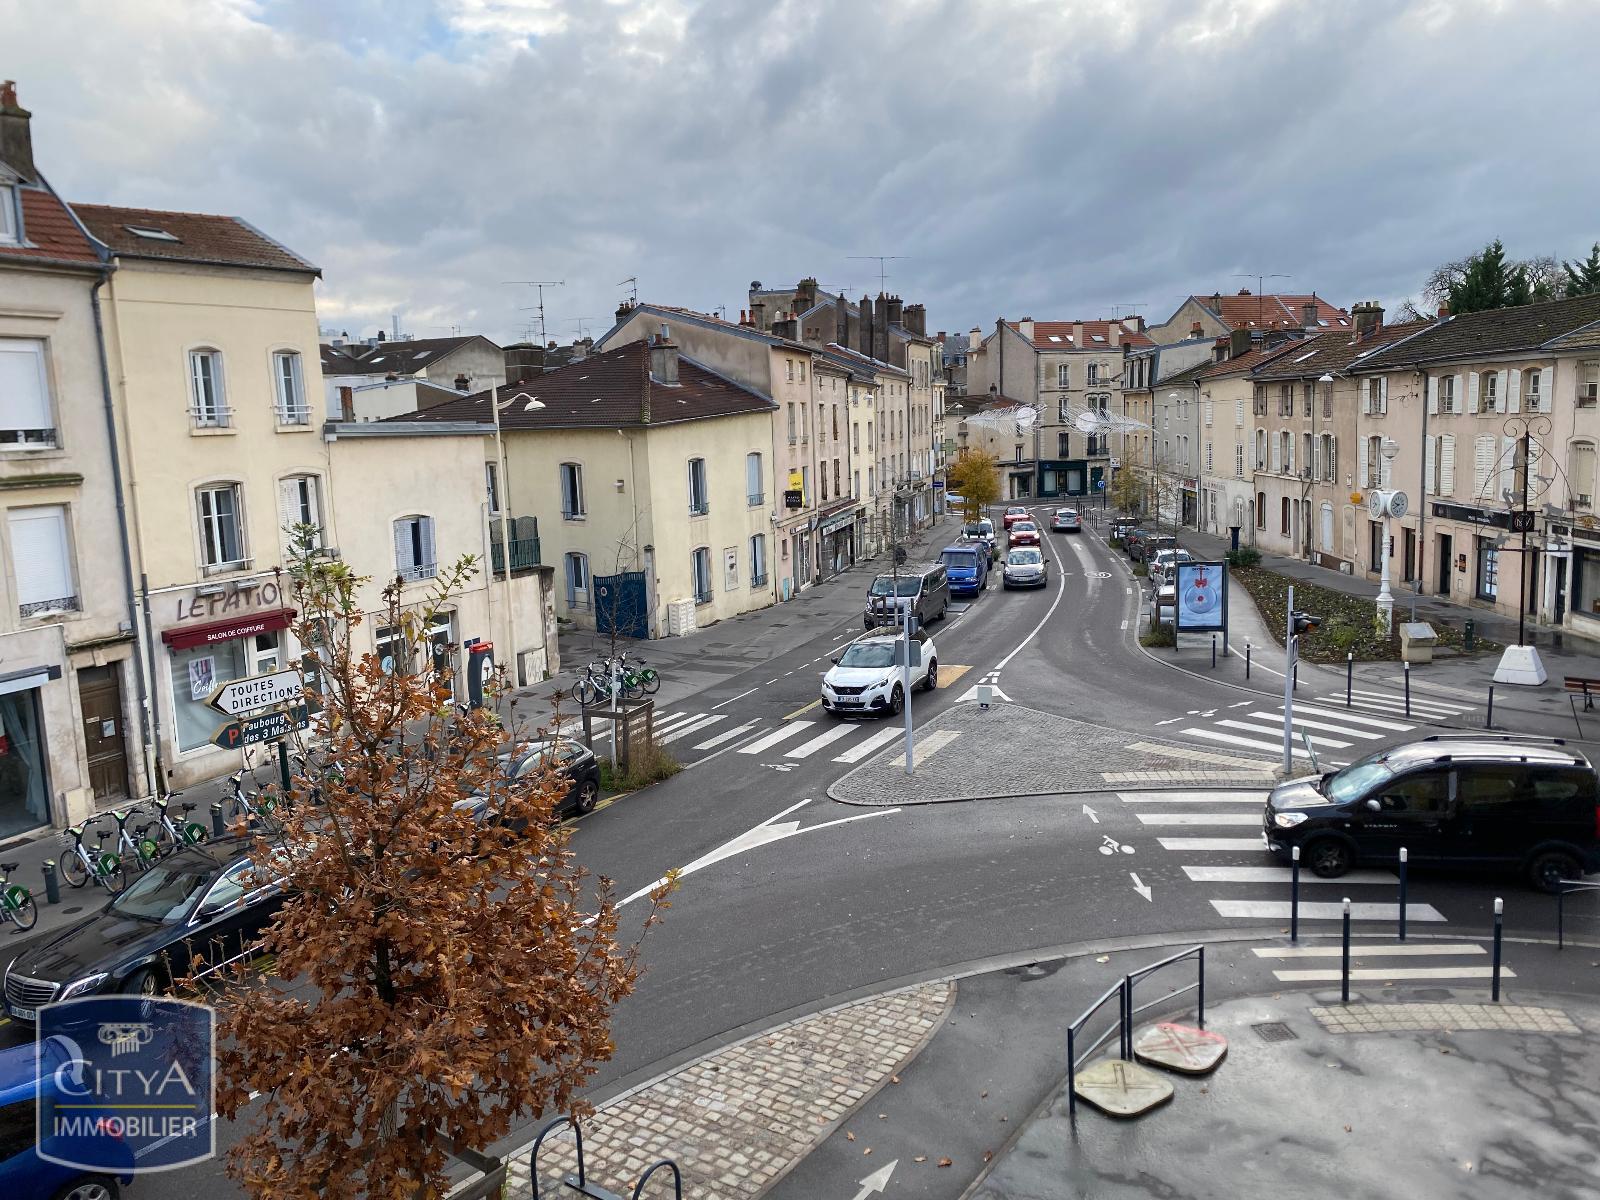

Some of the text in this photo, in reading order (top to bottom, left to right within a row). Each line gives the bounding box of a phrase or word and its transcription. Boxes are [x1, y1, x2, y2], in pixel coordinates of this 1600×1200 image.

[177, 582, 278, 621] LE PATIO
[207, 631, 228, 641] SALON
[237, 623, 265, 635] COIFFURE
[231, 680, 274, 697] TOUTES
[232, 685, 300, 709] DIRECTIONS
[228, 729, 239, 745] P
[244, 733, 260, 744] des
[262, 728, 269, 739] 3
